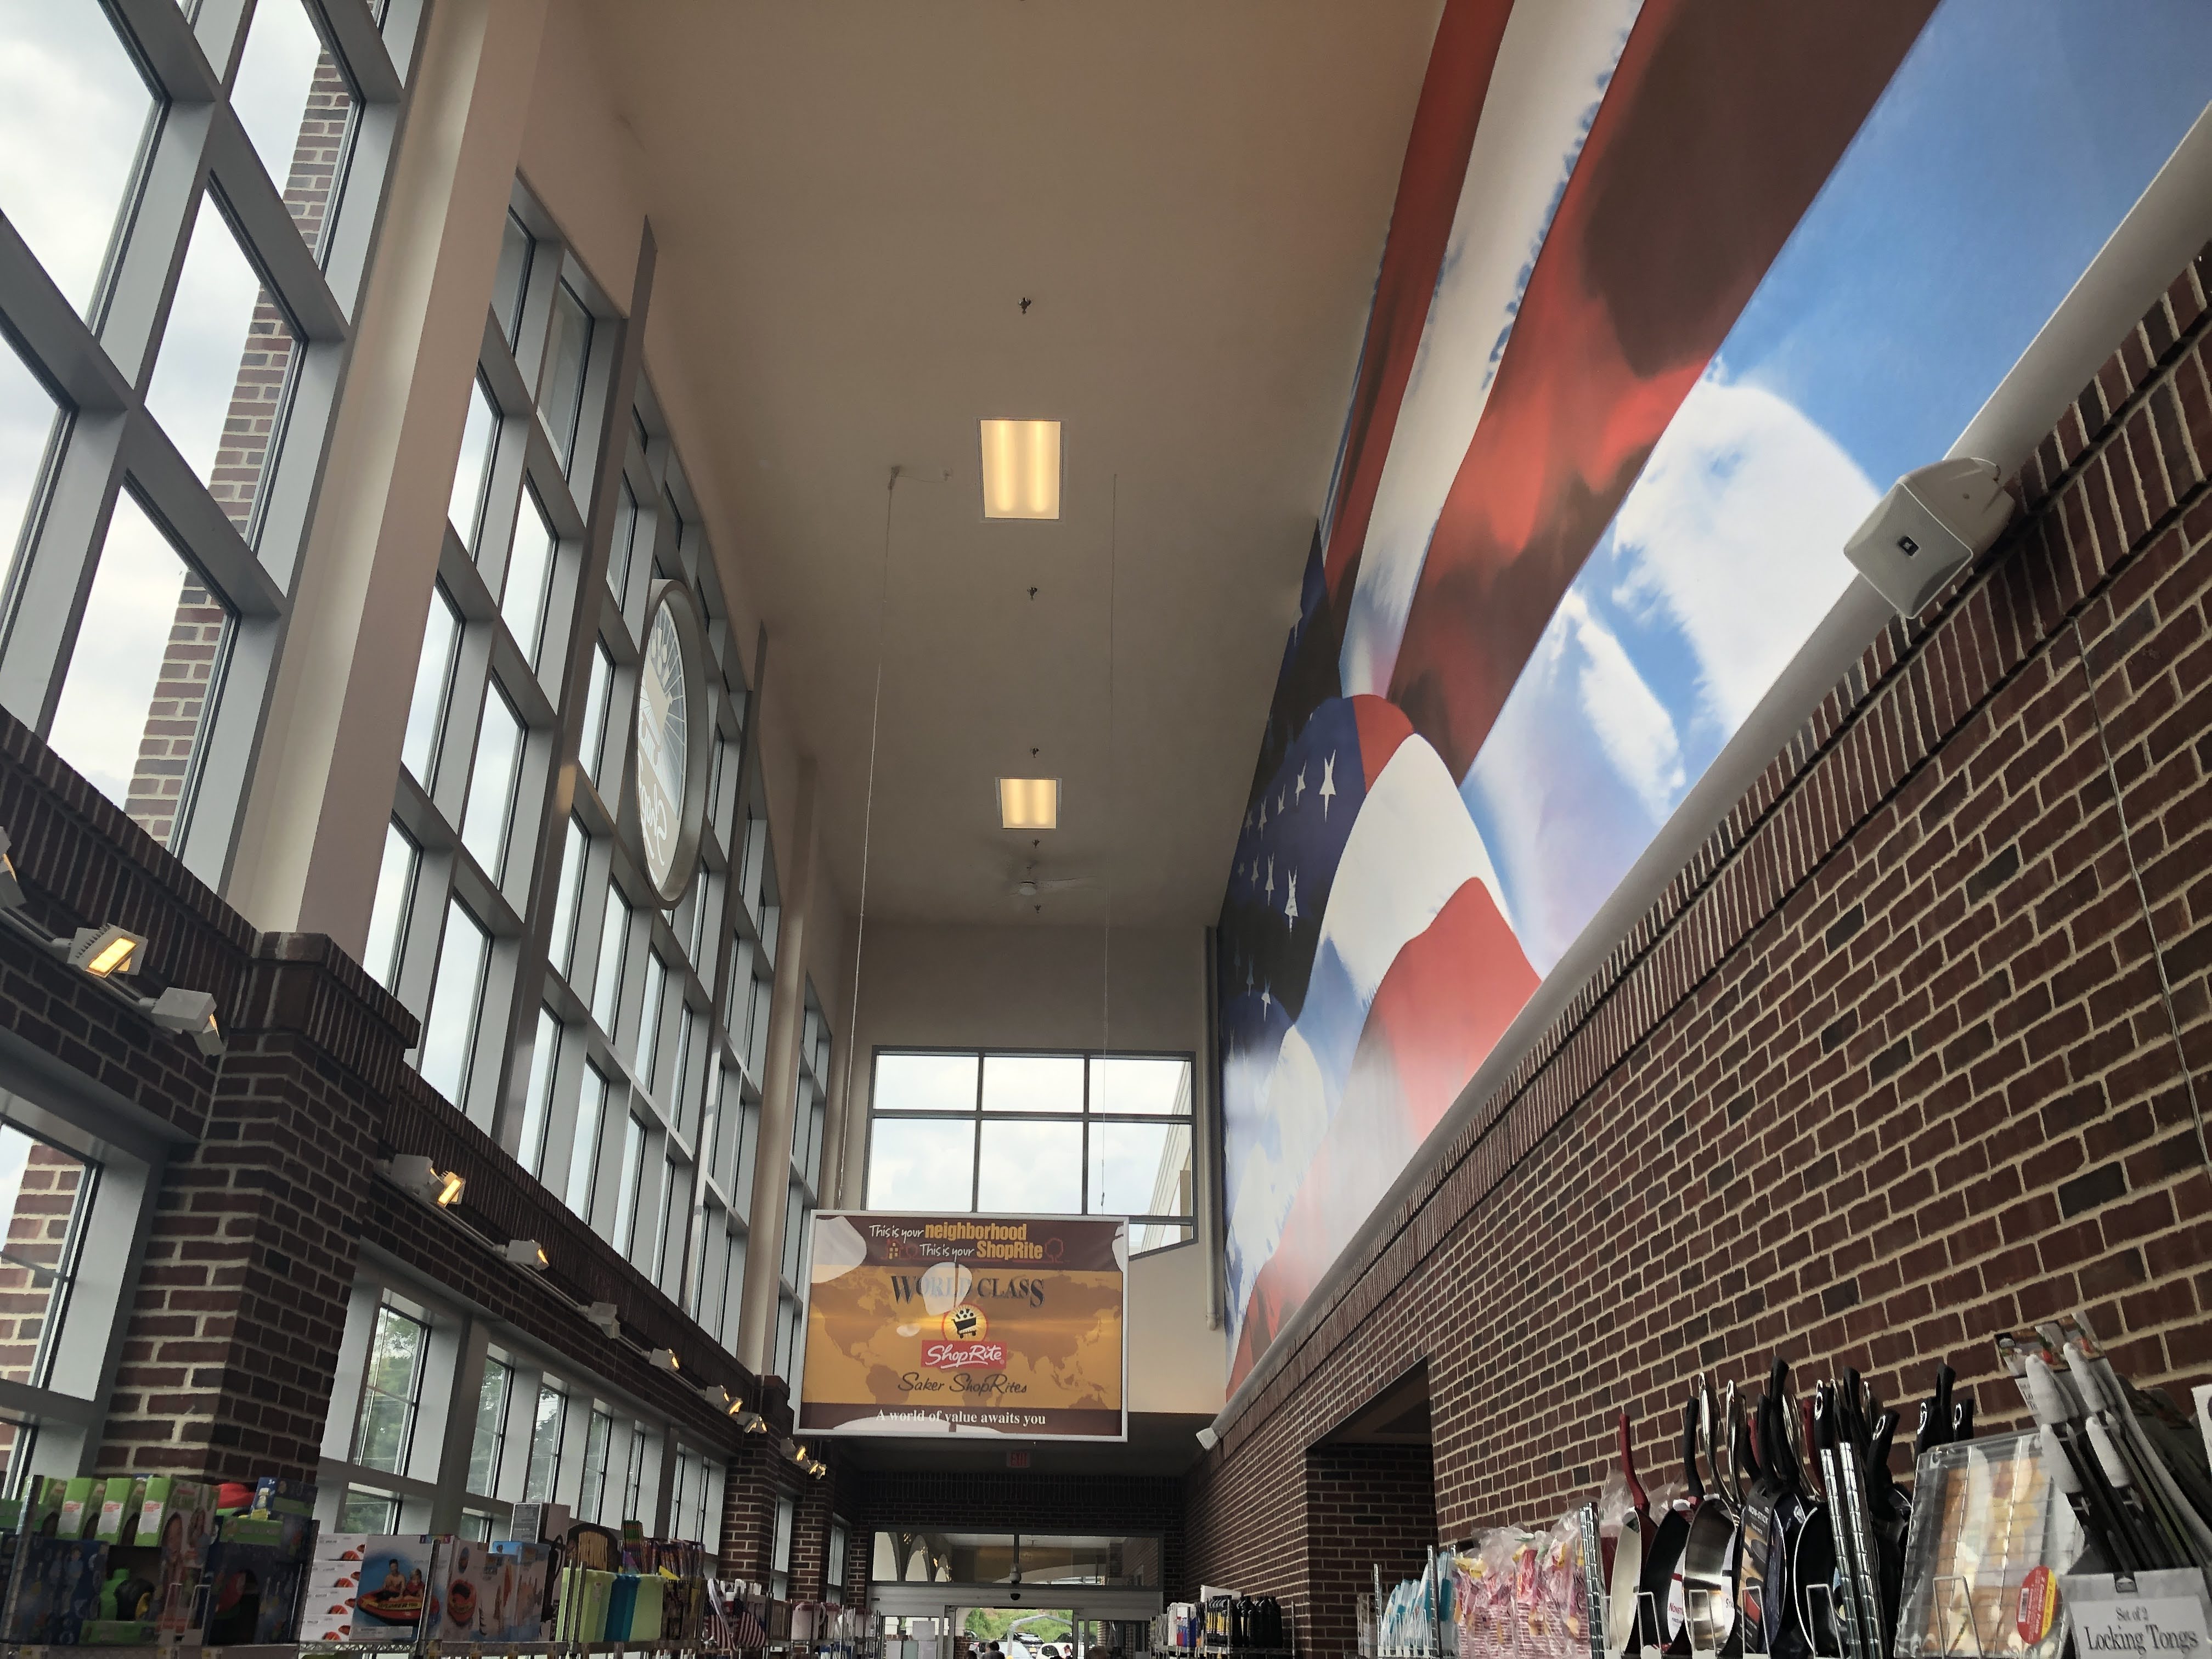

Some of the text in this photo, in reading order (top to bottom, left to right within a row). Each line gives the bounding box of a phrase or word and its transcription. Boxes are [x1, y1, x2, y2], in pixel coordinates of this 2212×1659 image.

[869, 1222, 1027, 1243] This is your neighborhood
[919, 1241, 1043, 1262] This is your ShopRite
[891, 1276, 1045, 1308] WORLD CLASS
[924, 1344, 1003, 1369] ShopRite
[898, 1372, 1028, 1397] Saker ShopRites
[876, 1409, 1047, 1427] A world of value awaits you
[1010, 1453, 1028, 1467] EXIT
[2084, 1623, 2200, 1656] Locking Tongs
